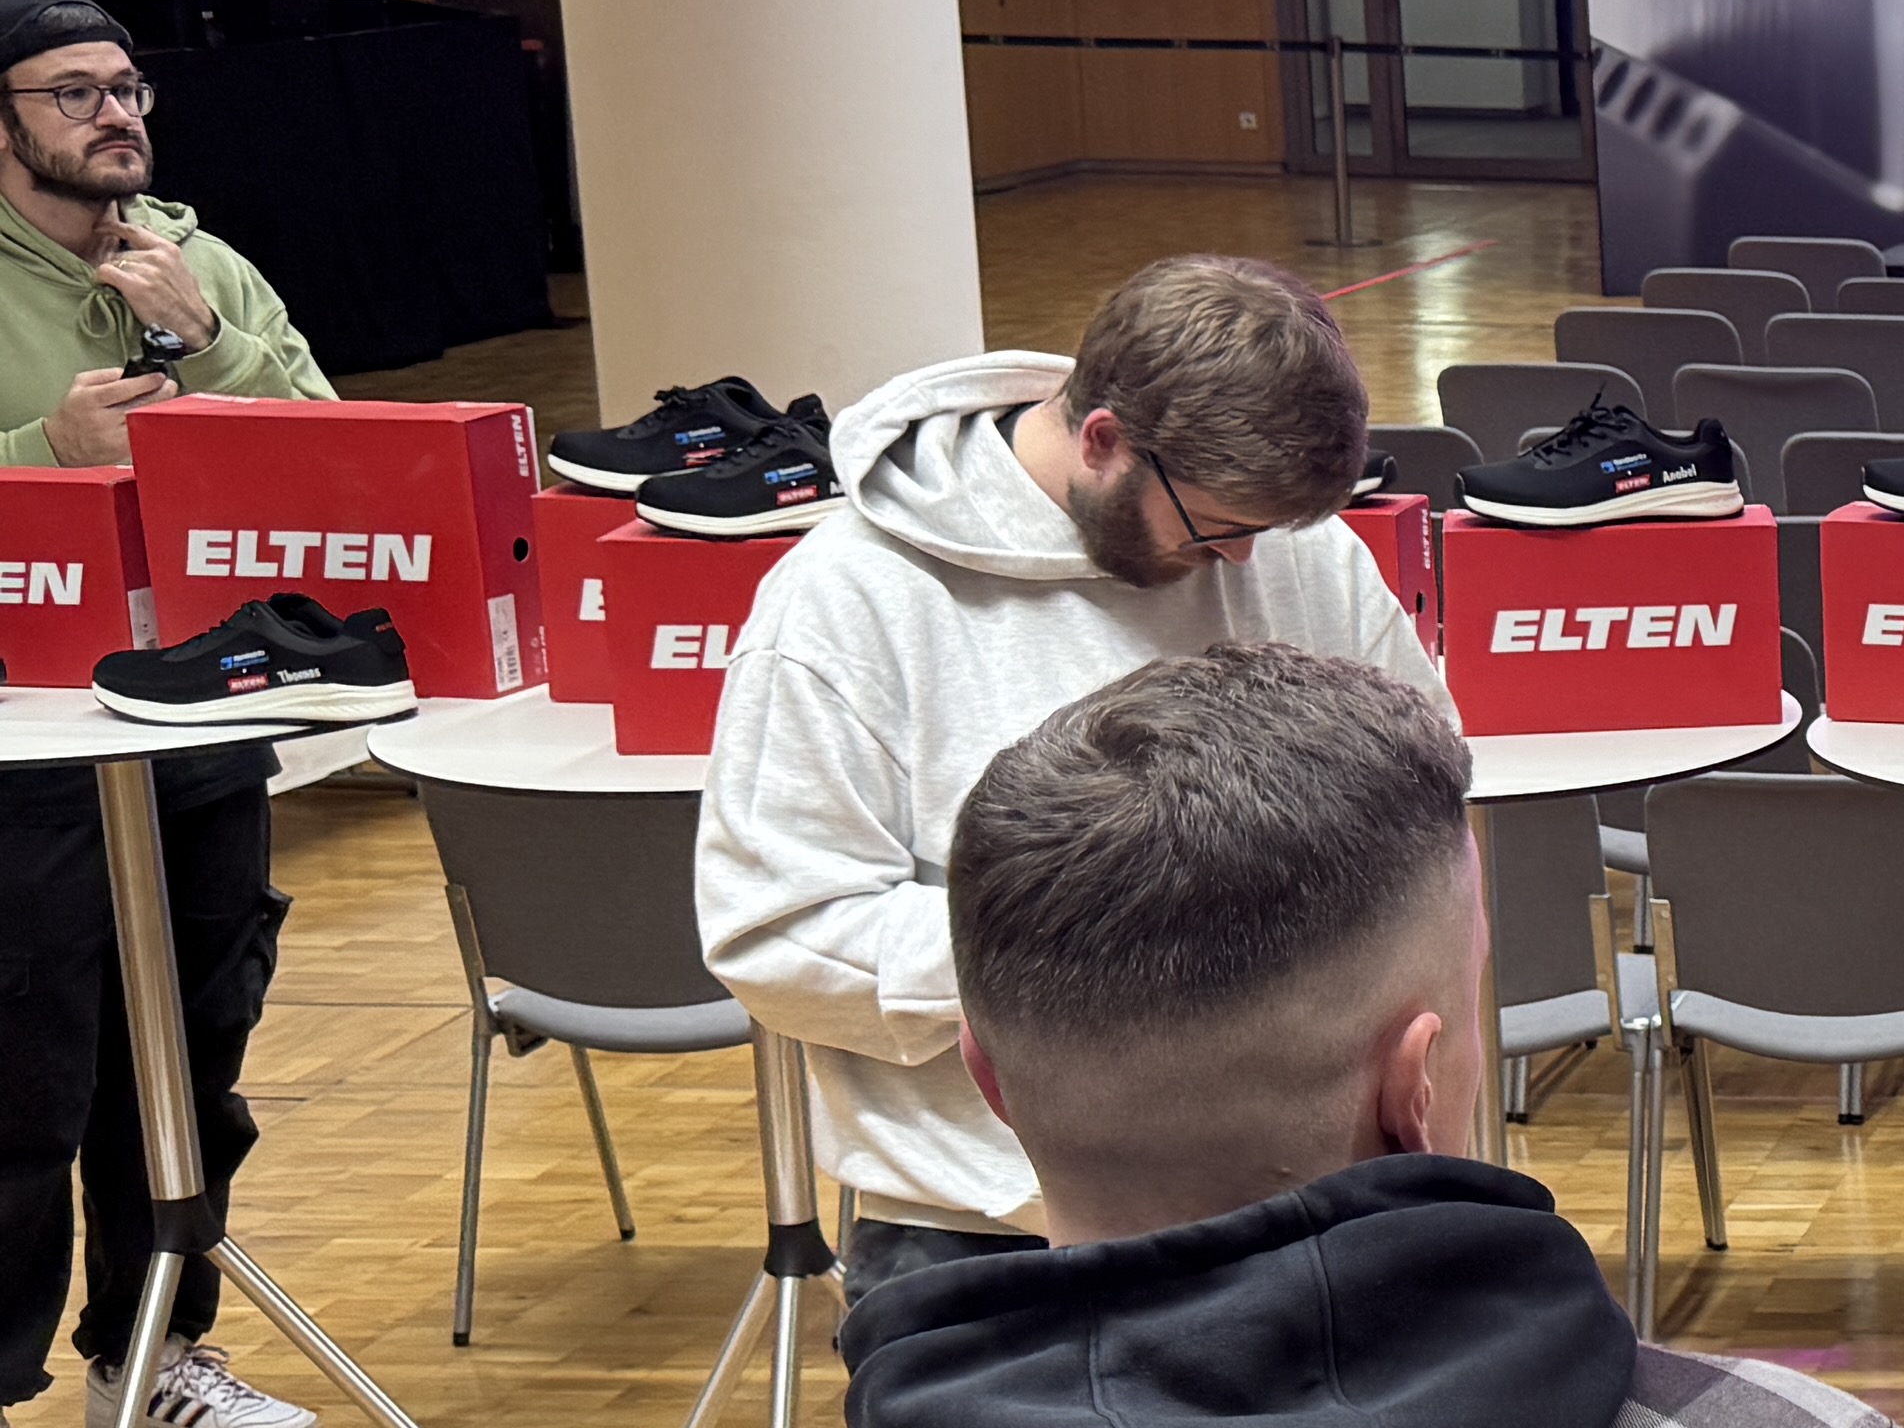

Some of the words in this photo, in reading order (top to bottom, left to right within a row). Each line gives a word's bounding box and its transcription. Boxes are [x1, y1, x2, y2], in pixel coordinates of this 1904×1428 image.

[510, 414, 530, 477] ELTEN
[186, 529, 433, 582] ELTEN
[1489, 603, 1738, 653] ELTEN
[277, 667, 321, 684] Thomas
